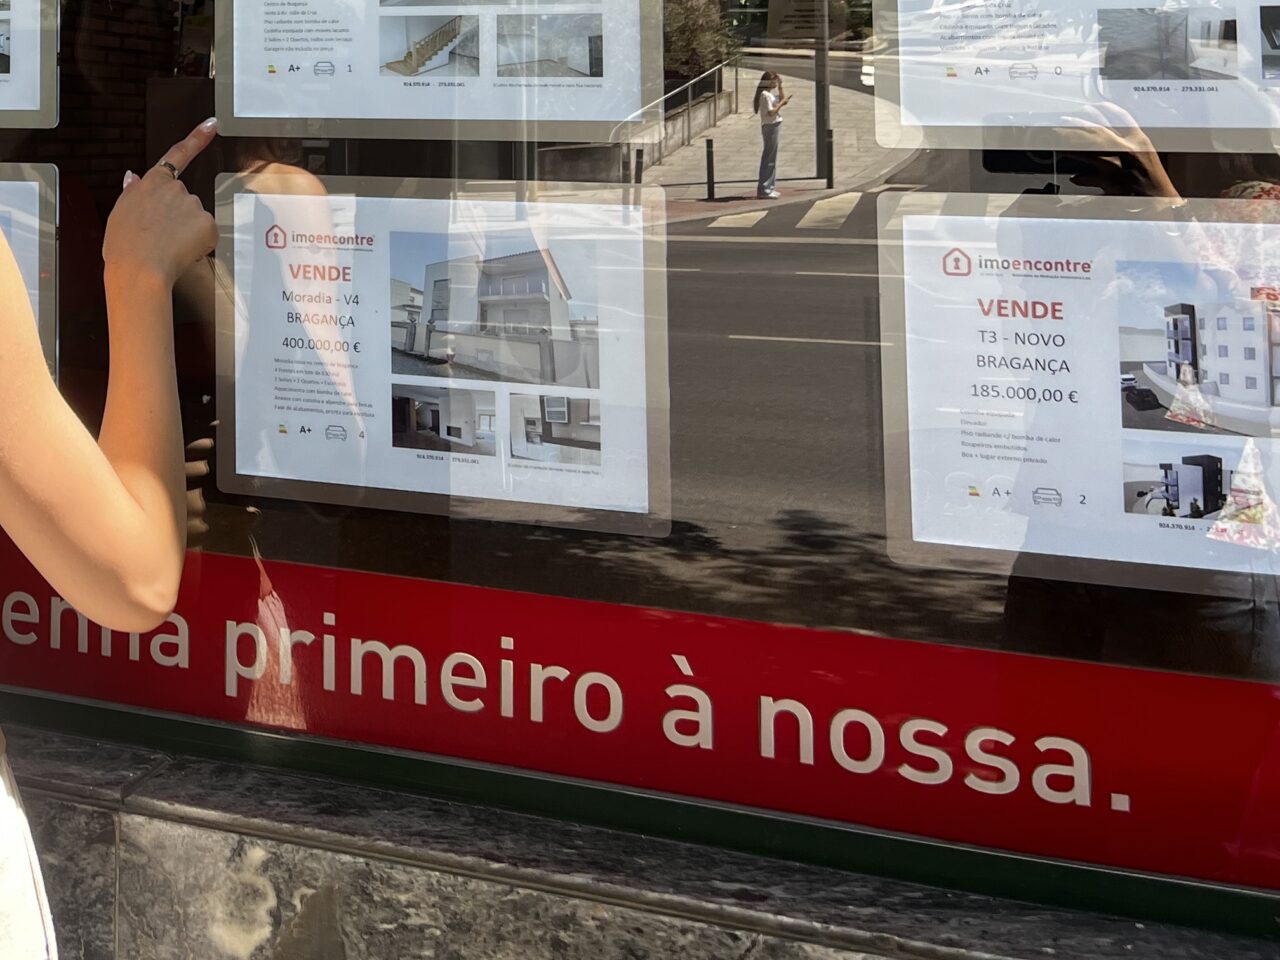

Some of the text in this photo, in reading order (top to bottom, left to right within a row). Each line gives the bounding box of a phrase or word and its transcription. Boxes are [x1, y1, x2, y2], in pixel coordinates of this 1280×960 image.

[288, 64, 301, 72] A+
[974, 66, 991, 76] A+
[292, 231, 374, 246] imoencontre
[289, 263, 352, 282] VENDE
[979, 255, 1091, 273] imoencontre
[282, 290, 332, 304] Moradia
[344, 294, 360, 306] V4
[977, 298, 1064, 321] VENDE
[287, 312, 355, 329] BRAGANÇA
[282, 337, 361, 354] 400.000,00 €
[978, 330, 998, 343] T3
[1014, 332, 1066, 347] NOVO
[976, 355, 1071, 375] BRAGANÇA
[971, 384, 1079, 404] 185.000,00 €
[300, 425, 312, 434] A+
[1080, 494, 1086, 505] 2
[225, 611, 624, 733] primeiro
[662, 653, 713, 750] à
[760, 694, 1132, 813] nossa.
